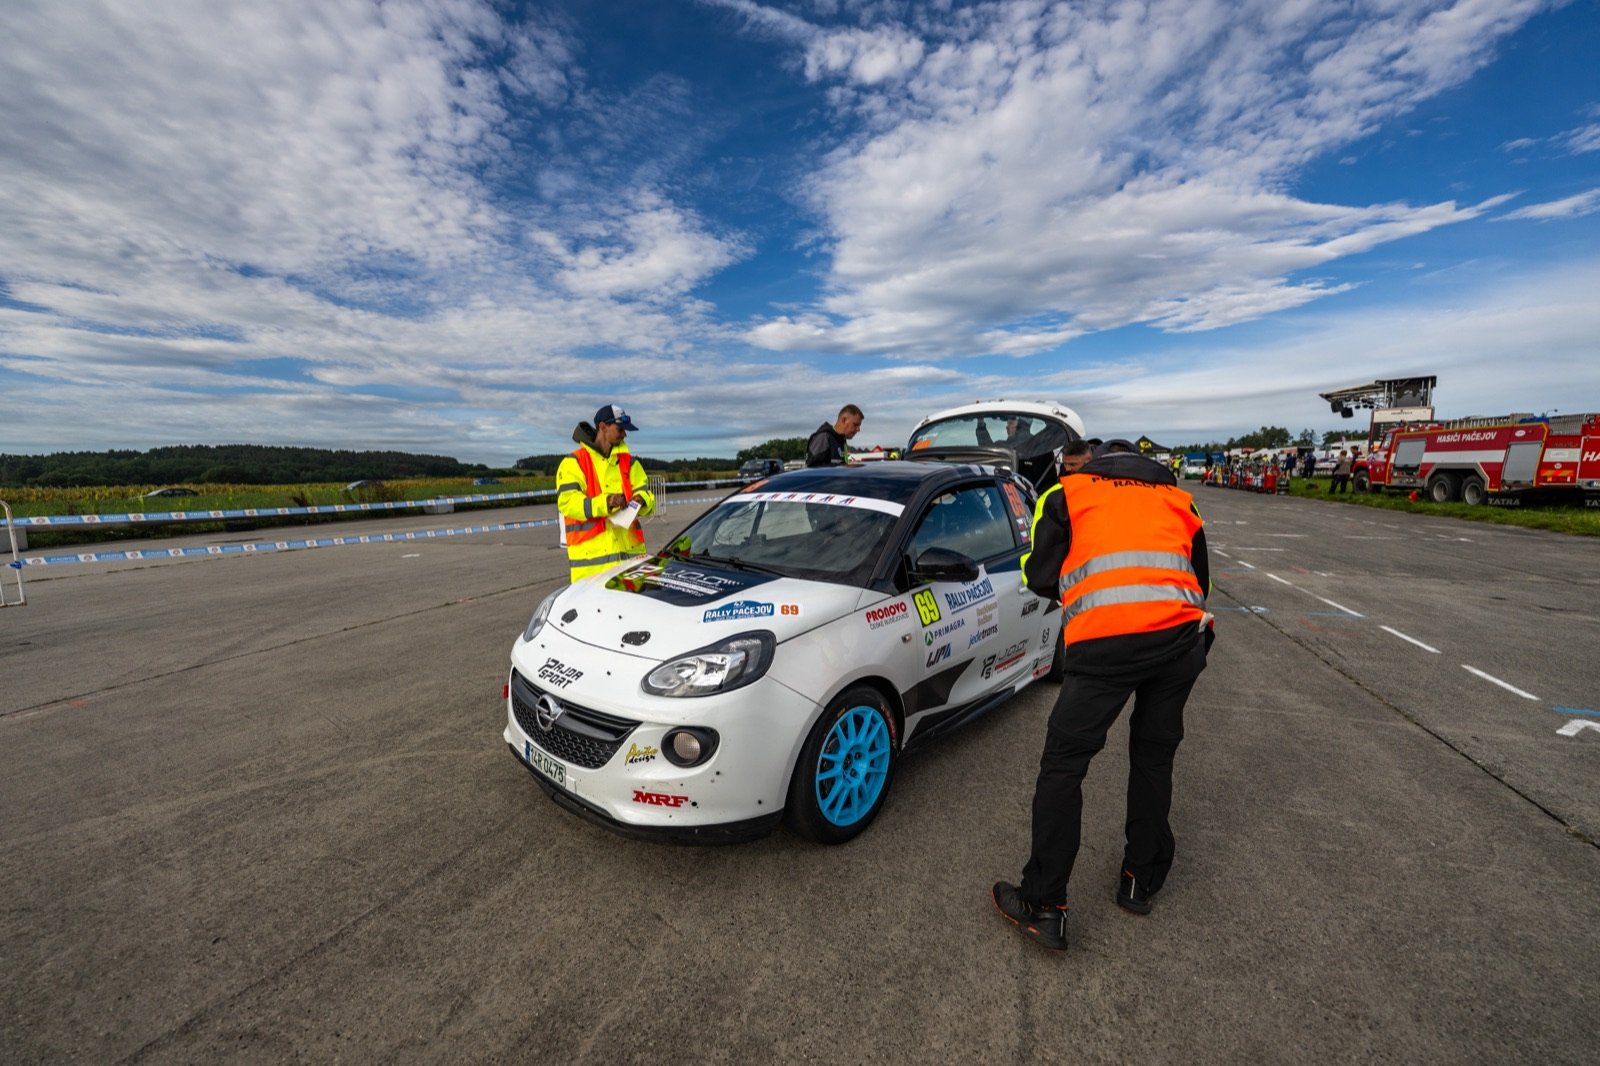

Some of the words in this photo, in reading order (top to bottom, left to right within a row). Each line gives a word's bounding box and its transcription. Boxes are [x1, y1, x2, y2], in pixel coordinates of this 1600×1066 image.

[1461, 430, 1497, 442] PAČEJOV
[1487, 498, 1520, 506] TATRA
[944, 590, 968, 610] RALLY
[966, 577, 994, 602] PAČEJOV
[705, 608, 731, 619] RALLY
[733, 603, 773, 615] PAČEJOV
[781, 604, 798, 615] 69
[914, 590, 940, 626] 69
[934, 618, 966, 639] PRIMAGRA
[538, 669, 573, 689] SPORT
[629, 755, 656, 764] design
[544, 757, 564, 783] 0475
[632, 790, 689, 808] MRF
